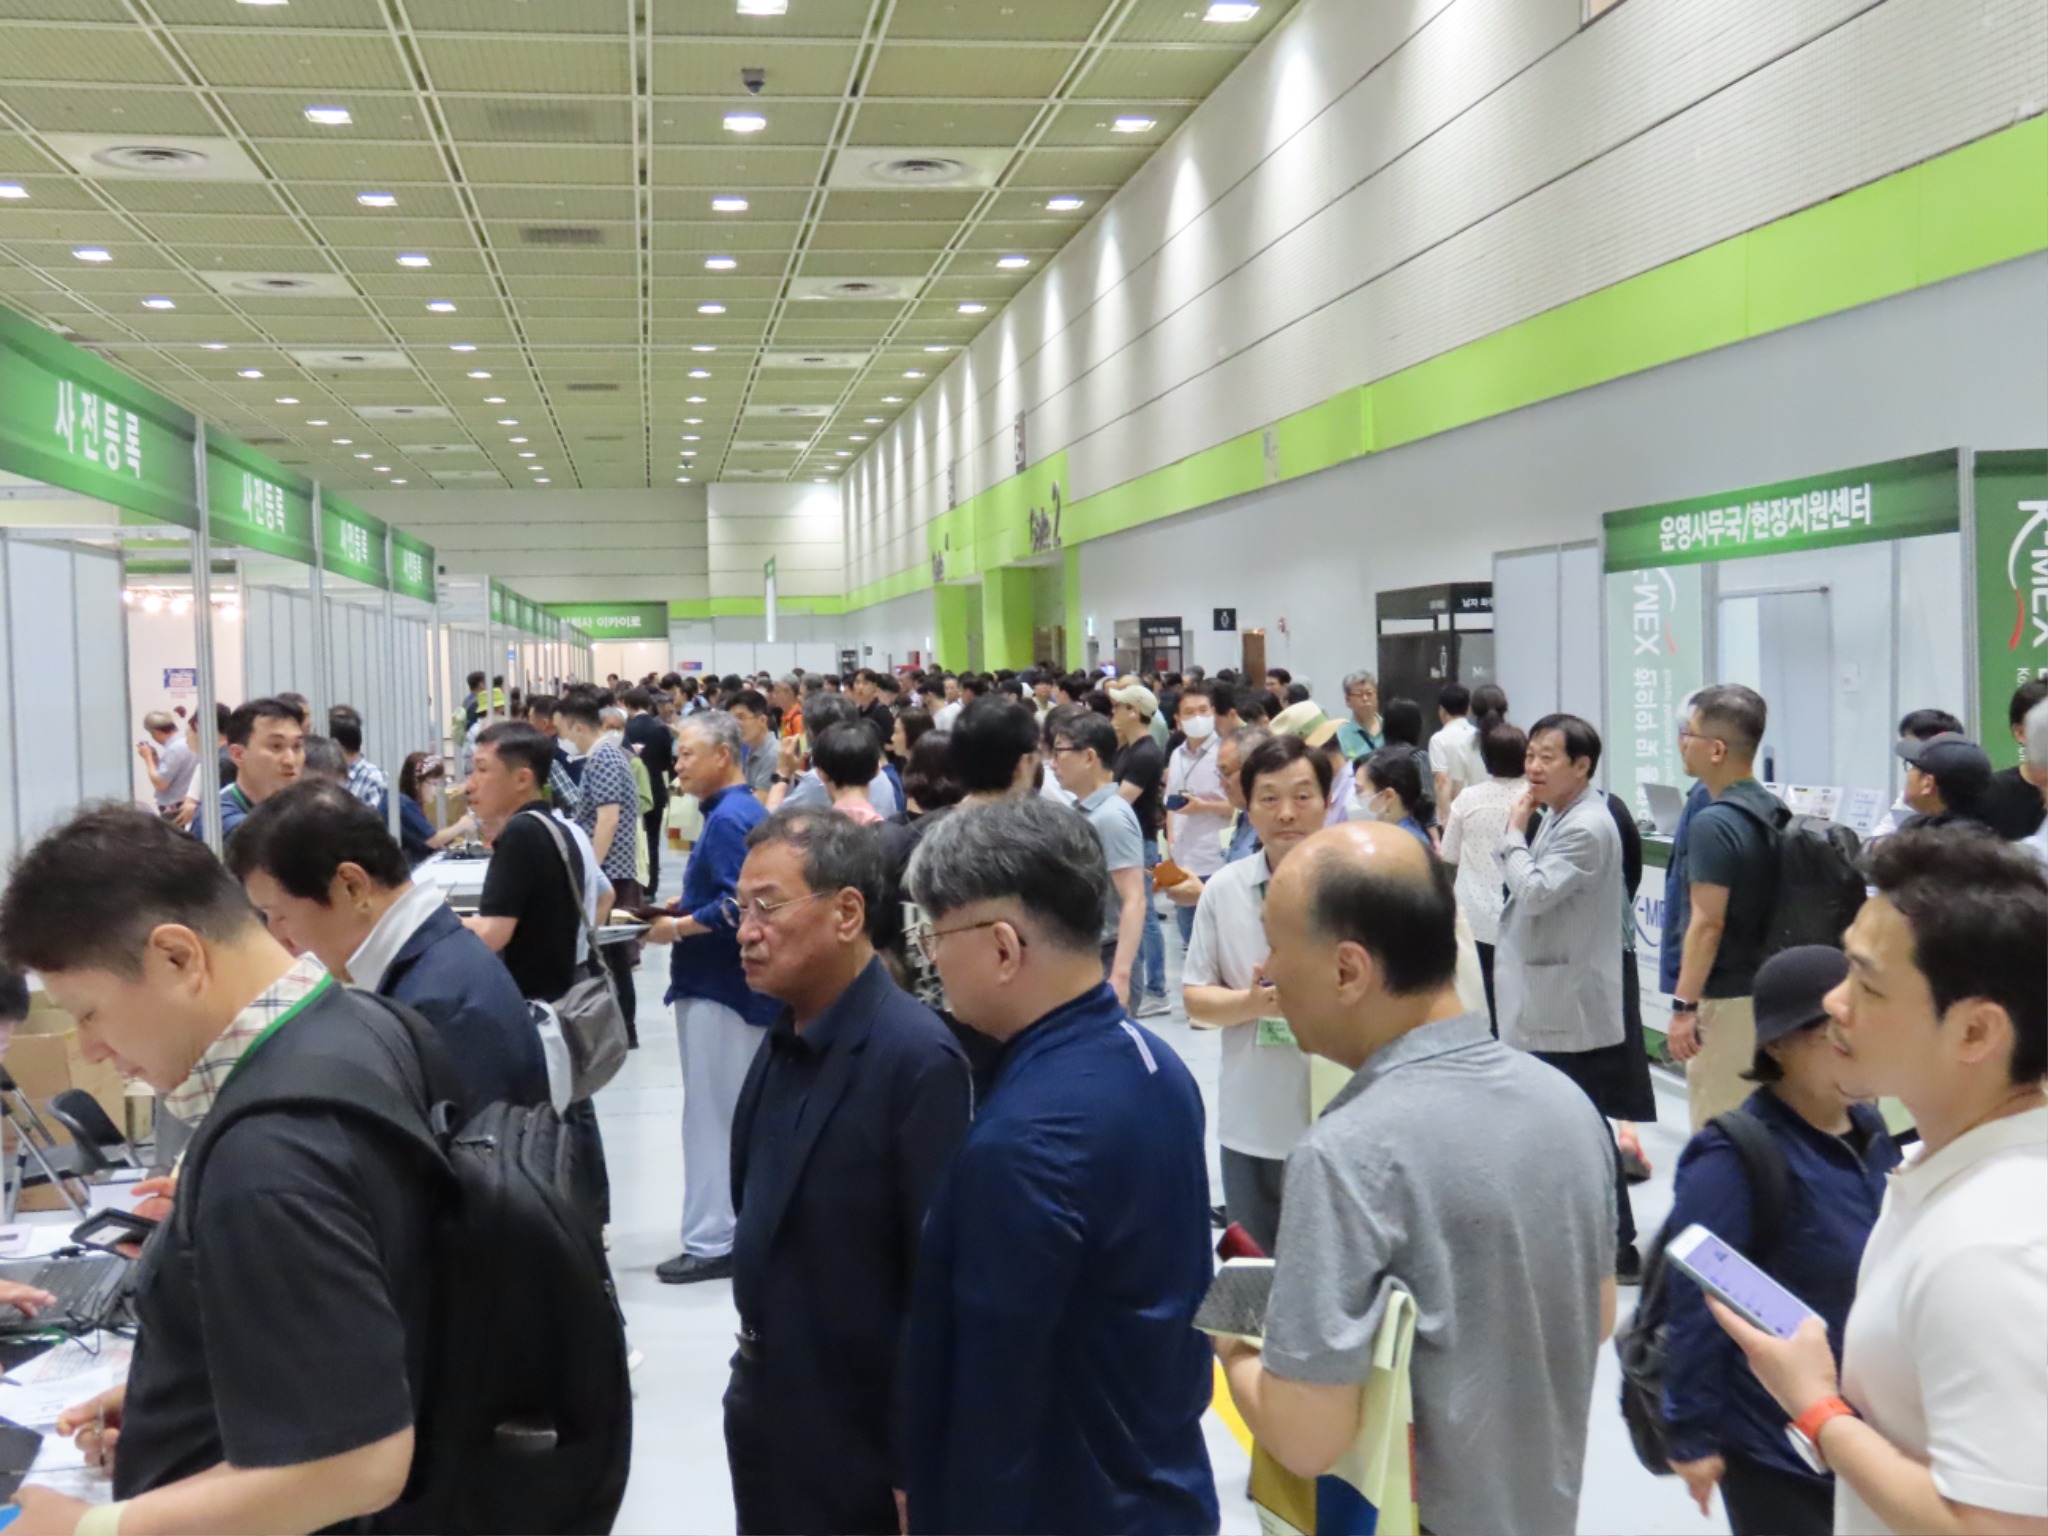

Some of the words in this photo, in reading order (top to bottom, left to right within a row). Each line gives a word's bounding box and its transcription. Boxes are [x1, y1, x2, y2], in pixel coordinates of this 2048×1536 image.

[55, 380, 141, 479] 사전등록
[242, 472, 286, 534] 사전등록
[1659, 482, 1872, 551] 운영사무국/현장지원센터
[597, 615, 642, 629] 이카이로
